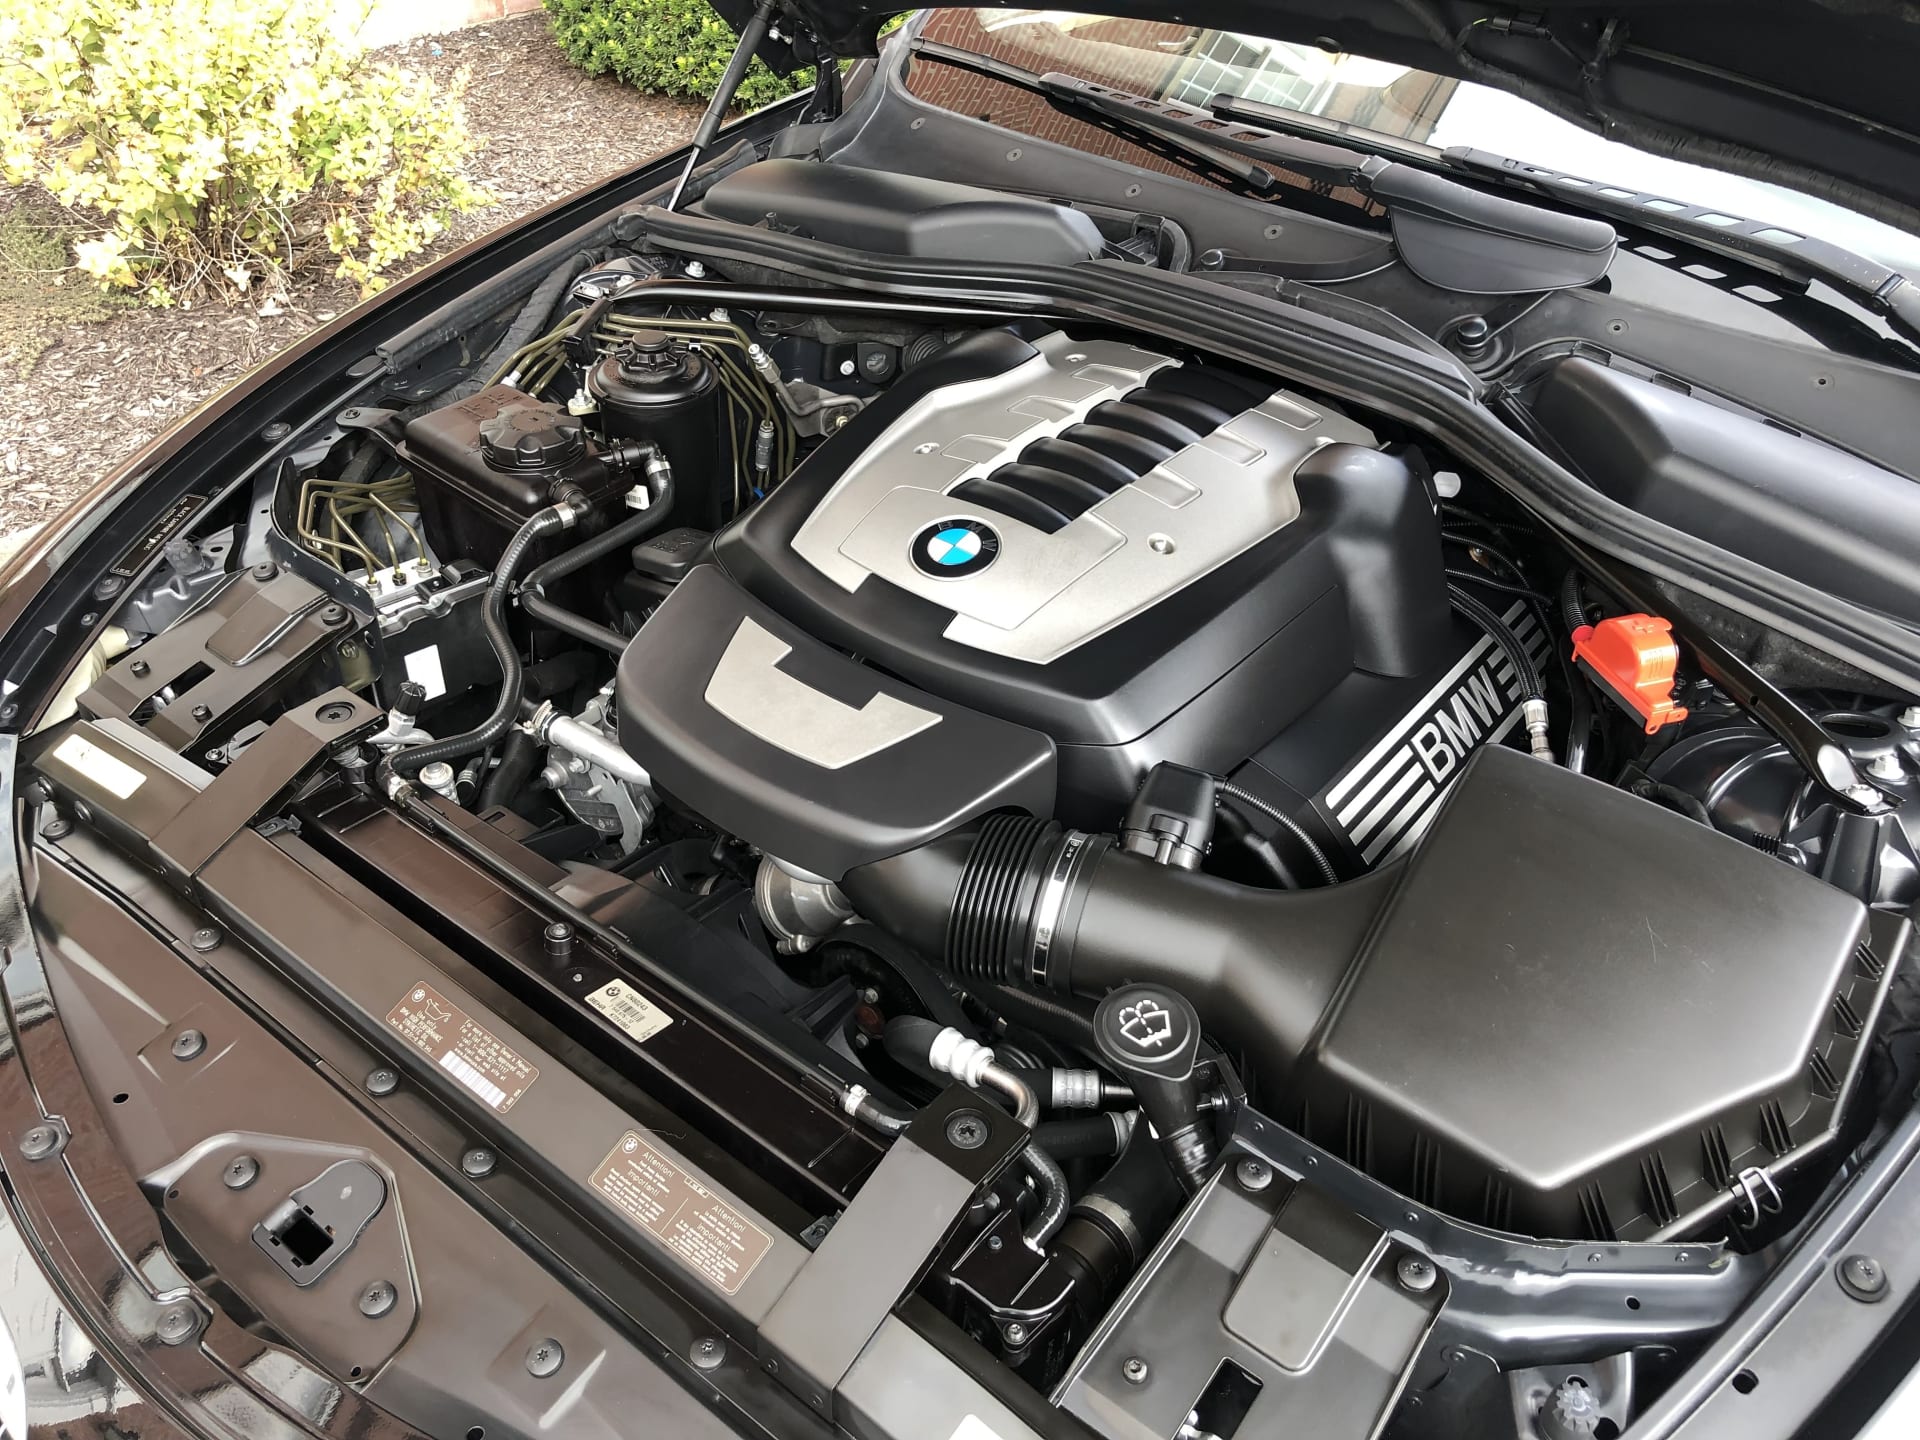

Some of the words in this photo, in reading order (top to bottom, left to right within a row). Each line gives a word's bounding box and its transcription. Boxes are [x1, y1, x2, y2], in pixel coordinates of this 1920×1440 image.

[938, 521, 997, 552] BMW
[1410, 665, 1504, 783] BMW
[416, 1010, 427, 1020] Use
[425, 1018, 438, 1030] only
[642, 1150, 674, 1177] Attention!
[626, 1169, 659, 1196] Important!
[711, 1204, 745, 1232] Attention!
[696, 1223, 731, 1251] Important!
